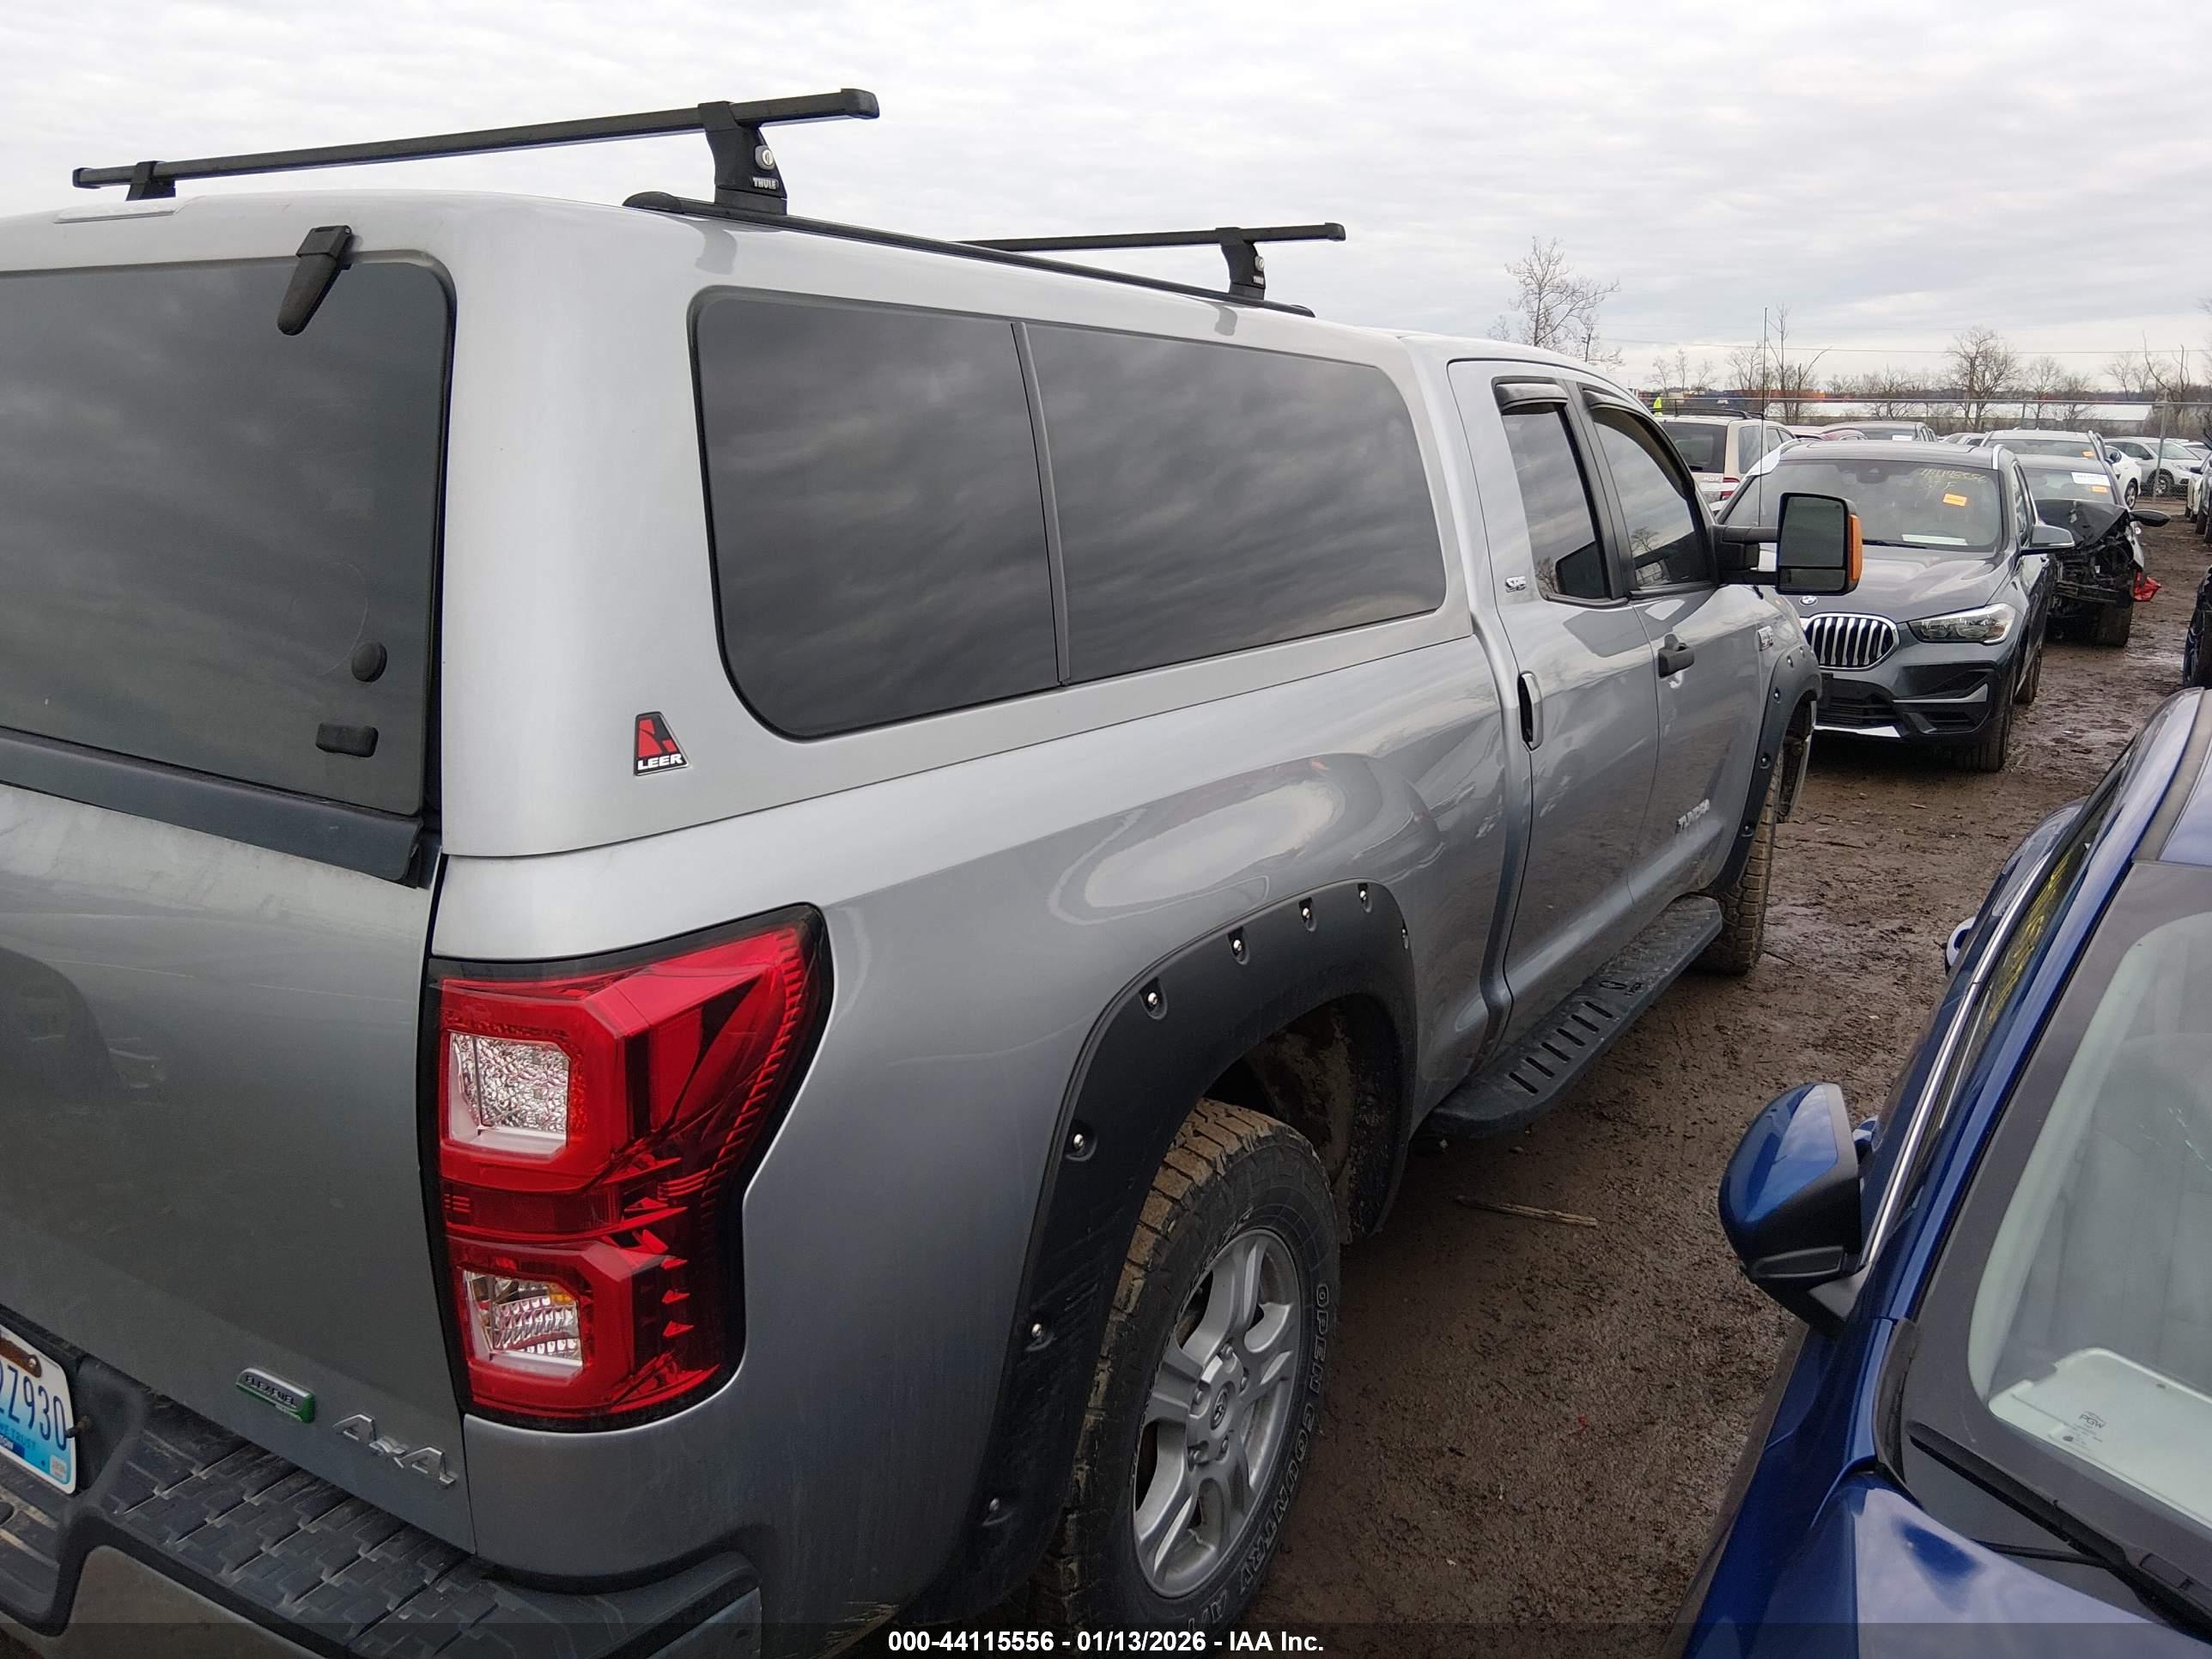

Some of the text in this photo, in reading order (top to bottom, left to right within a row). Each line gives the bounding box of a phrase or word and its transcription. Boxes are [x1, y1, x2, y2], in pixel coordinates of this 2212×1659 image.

[752, 177, 776, 190] THULE
[637, 753, 684, 771] LEER
[1310, 1283, 1329, 1395] OPEN
[0, 1358, 67, 1451] Z930
[2079, 1413, 2105, 1429] PGW
[1240, 1402, 1316, 1595] COUNTRY
